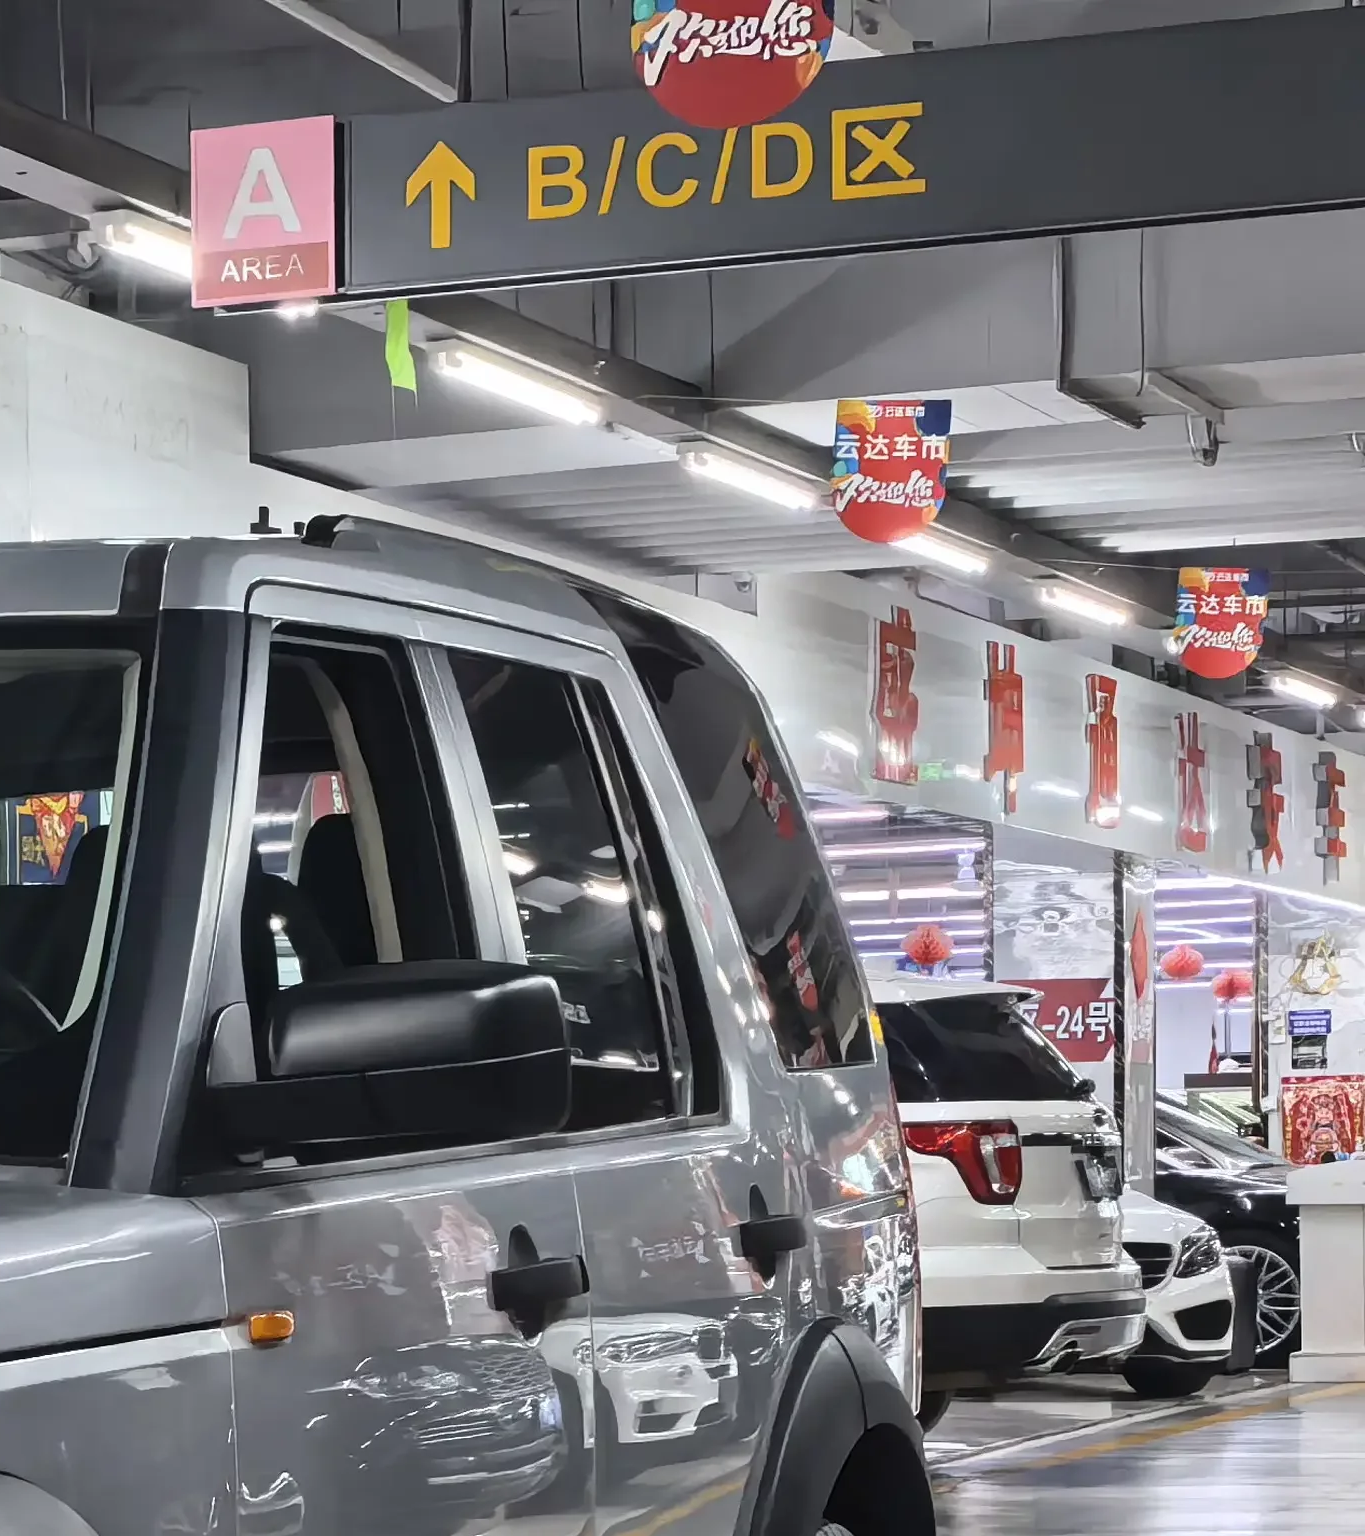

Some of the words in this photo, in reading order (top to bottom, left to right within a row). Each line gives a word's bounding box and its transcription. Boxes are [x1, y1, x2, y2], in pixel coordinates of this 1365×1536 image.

[643, 0, 818, 86] 欢迎您
[527, 102, 926, 220] B/C/D区
[222, 146, 302, 240] A
[220, 254, 305, 283] AREA
[836, 434, 947, 460] 云达车市
[836, 469, 935, 513] 欢迎您
[1177, 594, 1267, 616] 云达车市
[1177, 623, 1255, 656] 欢迎您
